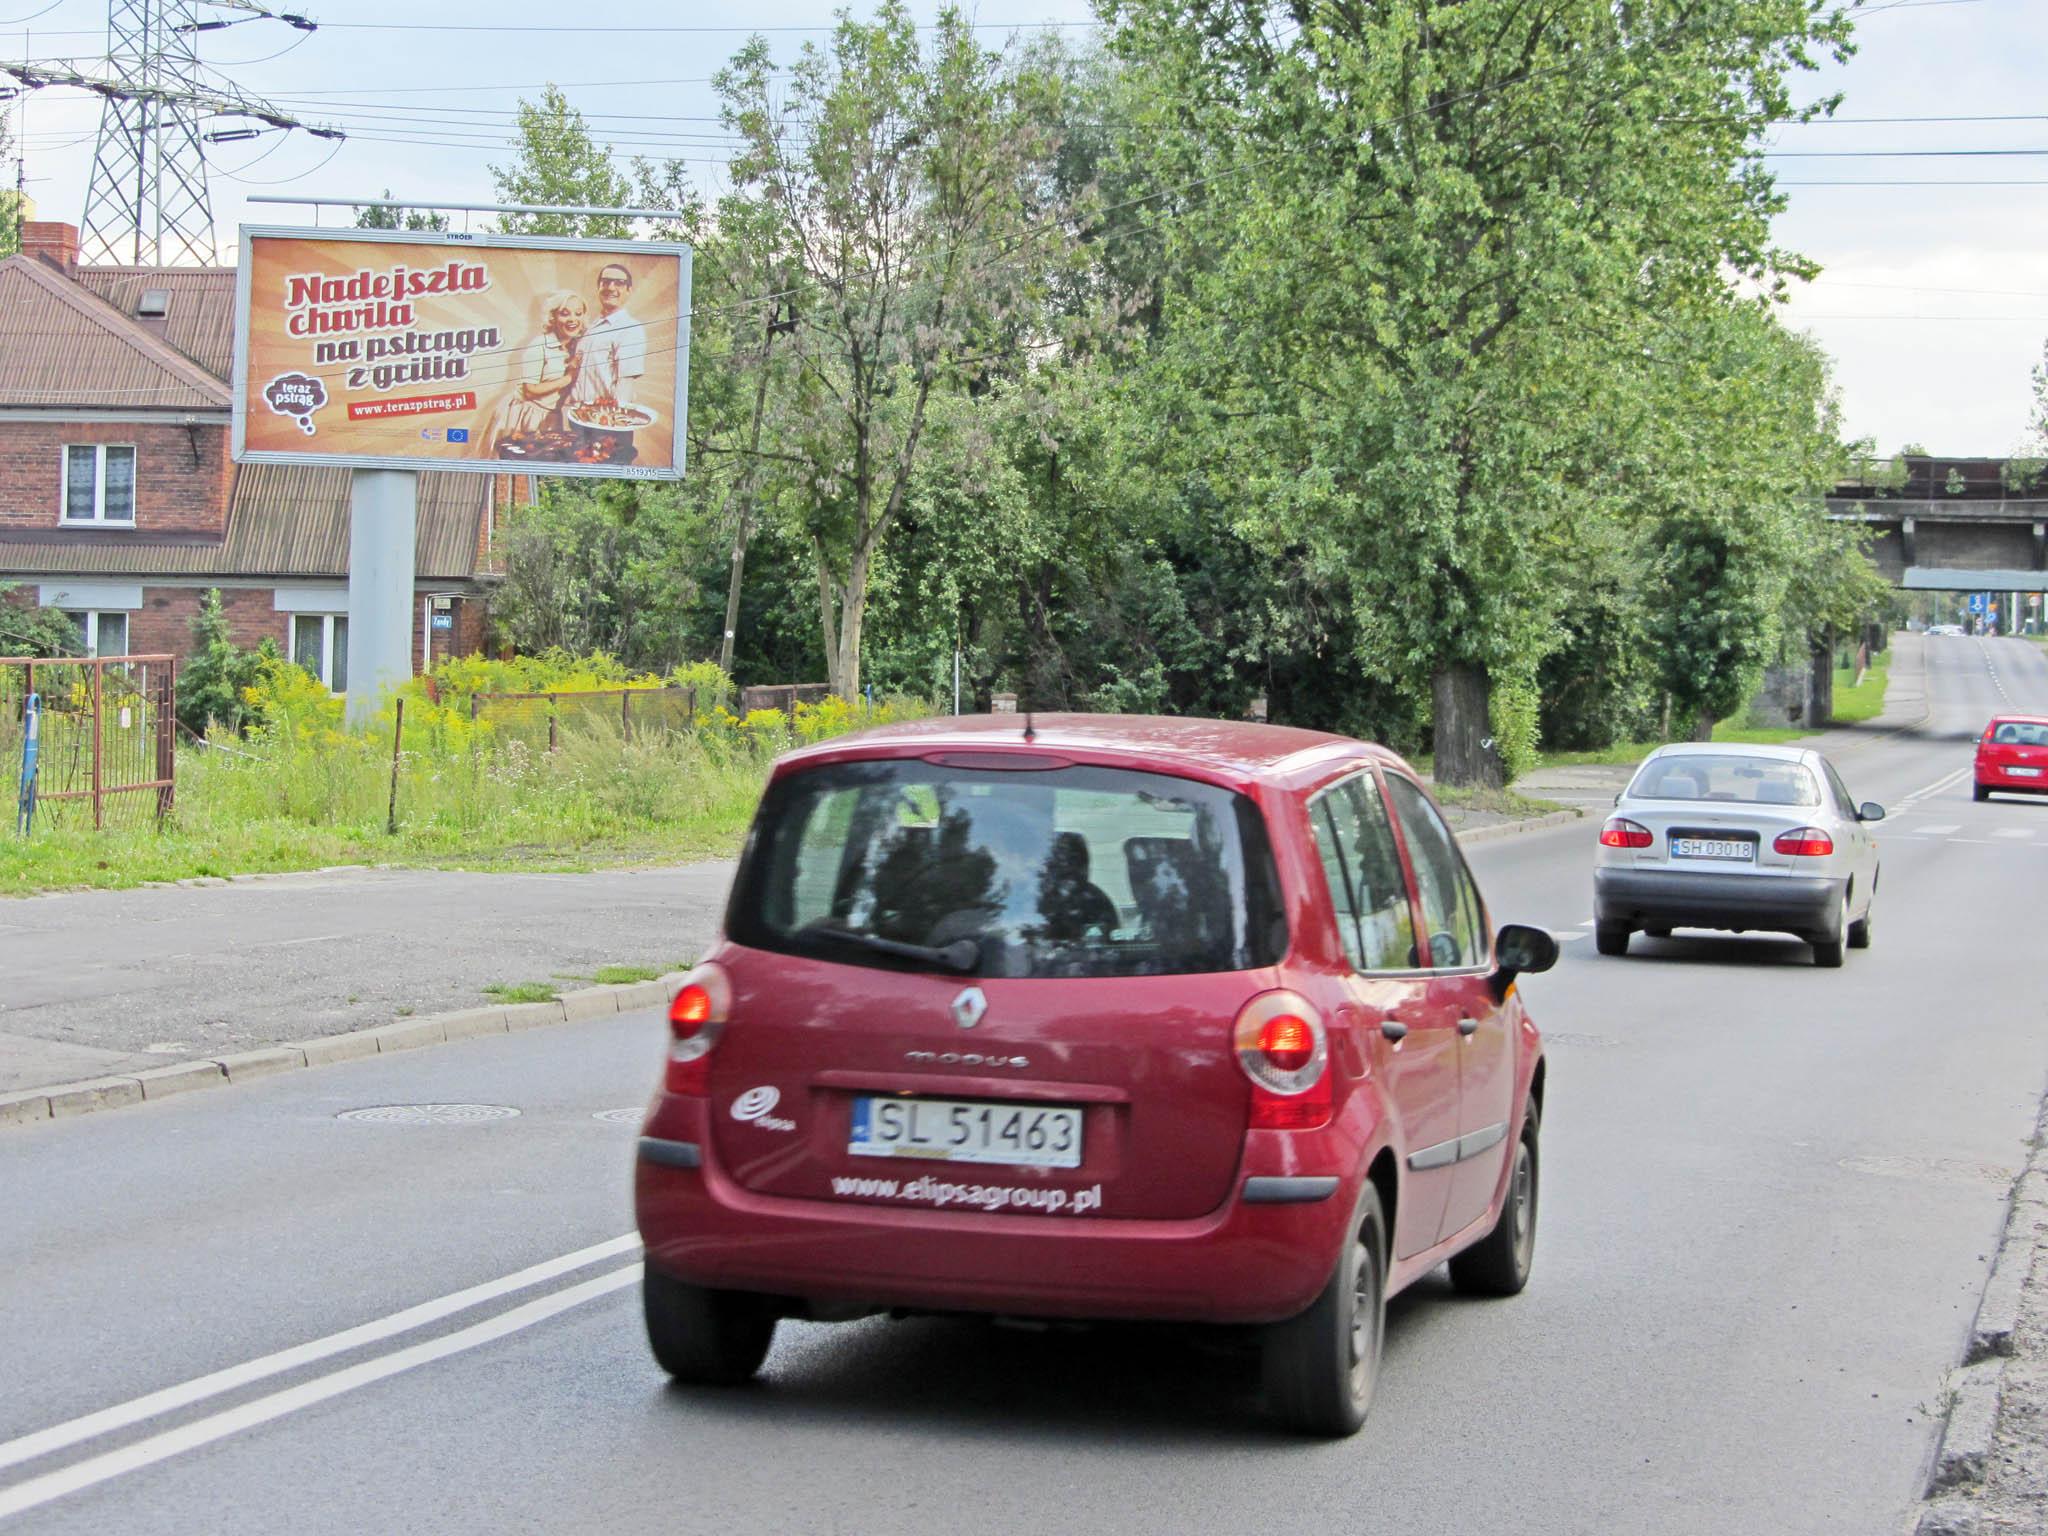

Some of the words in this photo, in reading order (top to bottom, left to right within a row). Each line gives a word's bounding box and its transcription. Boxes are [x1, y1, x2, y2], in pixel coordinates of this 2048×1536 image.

[288, 263, 488, 307] Nadejszła
[289, 301, 415, 336] chwila
[316, 340, 361, 363] na
[348, 367, 367, 388] z
[373, 355, 468, 390] grilla
[275, 393, 315, 407] pstrąg
[282, 382, 312, 394] teraz
[354, 395, 467, 416] www.terazpstrag.pl
[1680, 840, 1702, 855] SH
[1706, 842, 1751, 857] 03018
[877, 1103, 932, 1144] SL
[949, 1106, 1074, 1152] 51463
[831, 1176, 1102, 1214] www.elipsagroup.pl
